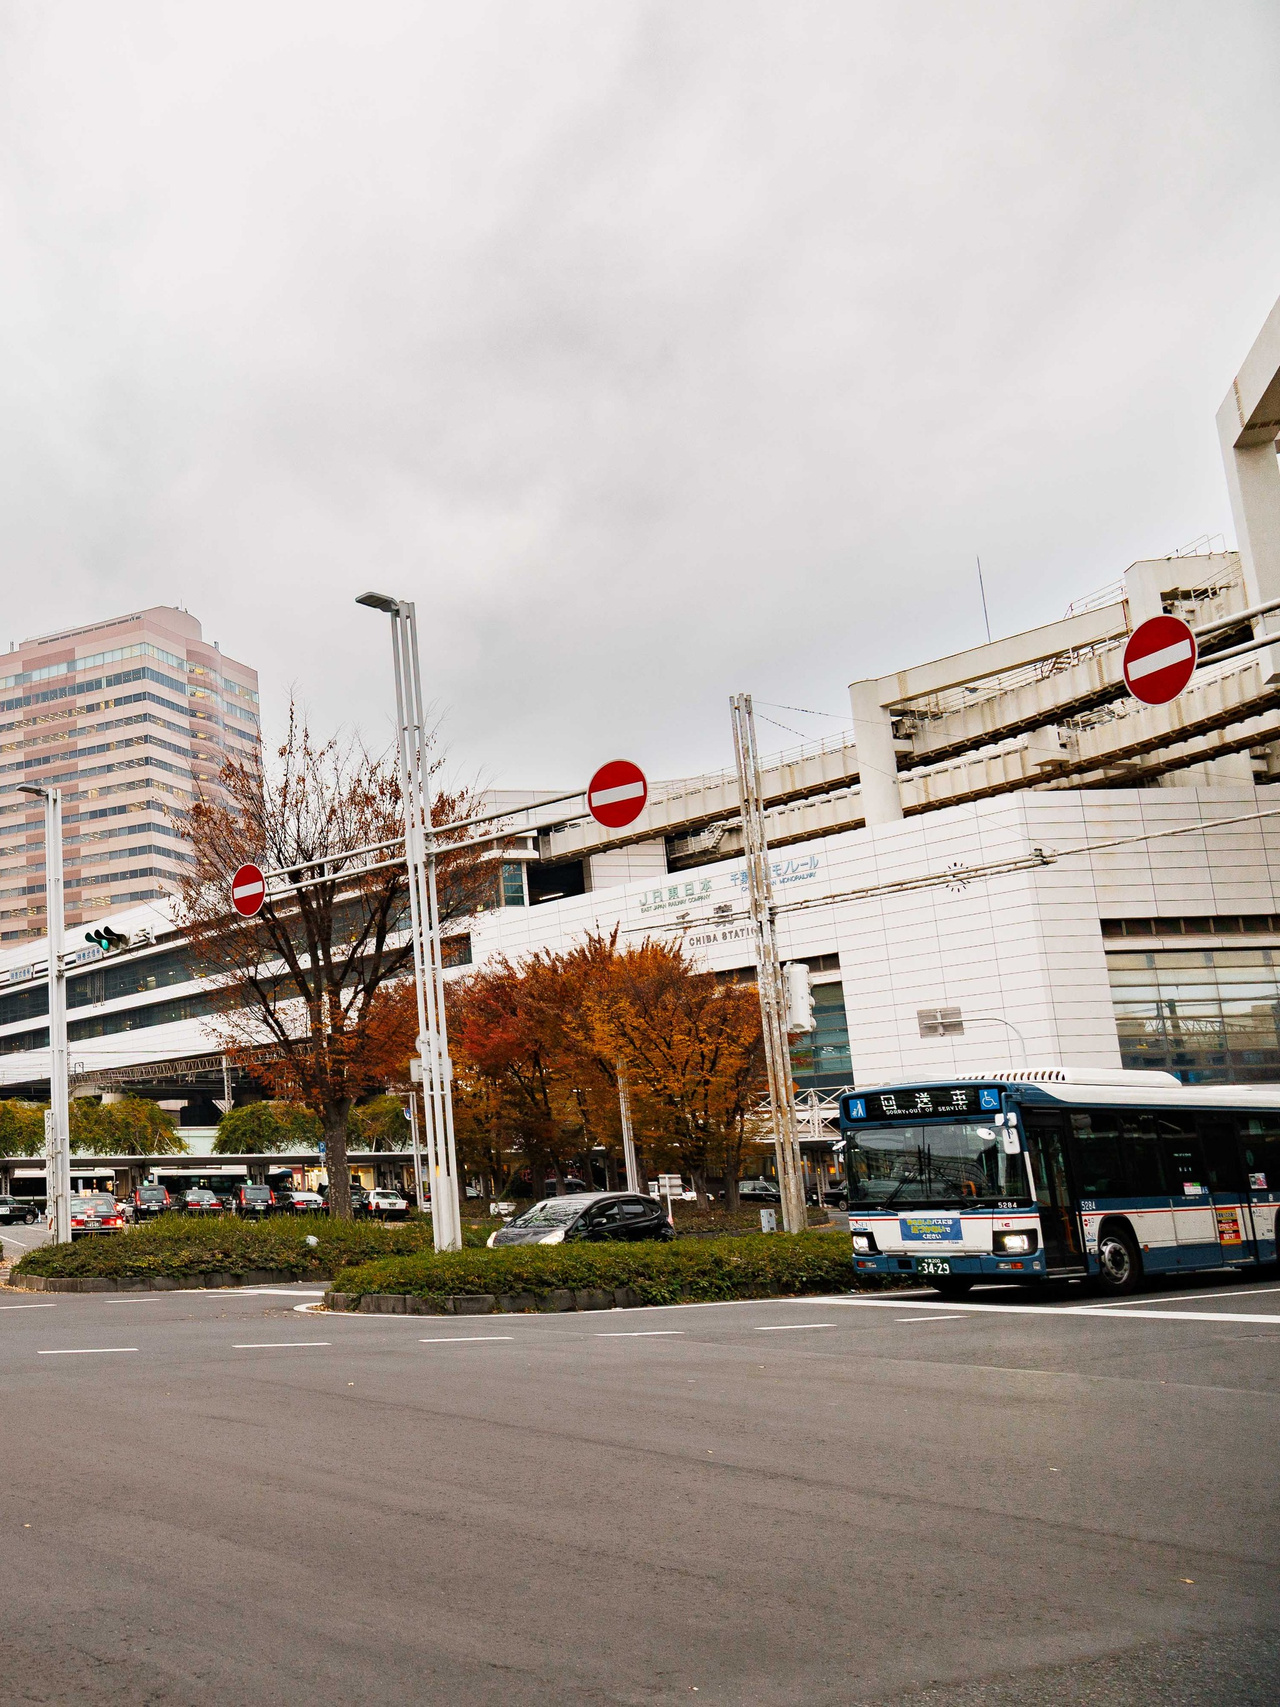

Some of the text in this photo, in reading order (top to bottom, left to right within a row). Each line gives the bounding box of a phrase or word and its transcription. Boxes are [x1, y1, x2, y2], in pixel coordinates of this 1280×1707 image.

[730, 856, 819, 886] 千葉モノレール
[639, 879, 712, 906] JR東日本
[640, 893, 711, 914] EAST JAPAN RAILWAY COMPANY
[689, 932, 718, 947] CHIBA
[880, 1089, 968, 1111] 回送車
[937, 1104, 968, 1112] SERVICE
[1081, 1200, 1096, 1211] 5284
